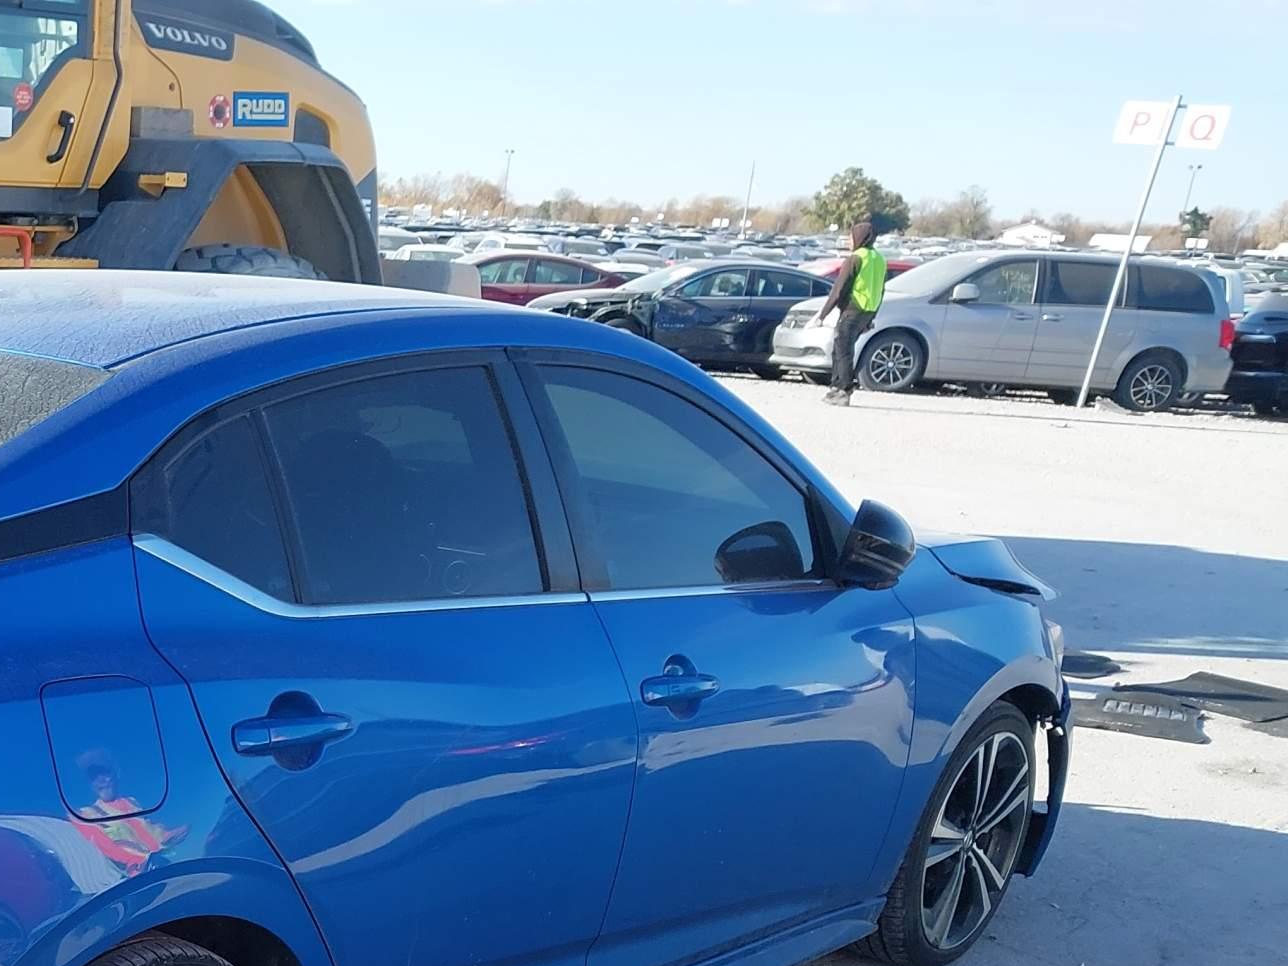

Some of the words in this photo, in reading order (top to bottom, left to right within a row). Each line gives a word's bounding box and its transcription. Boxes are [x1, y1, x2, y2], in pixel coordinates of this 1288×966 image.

[145, 22, 227, 50] VOLVO
[238, 99, 285, 120] RUDD
[1129, 112, 1151, 135] P
[1189, 115, 1216, 141] Q
